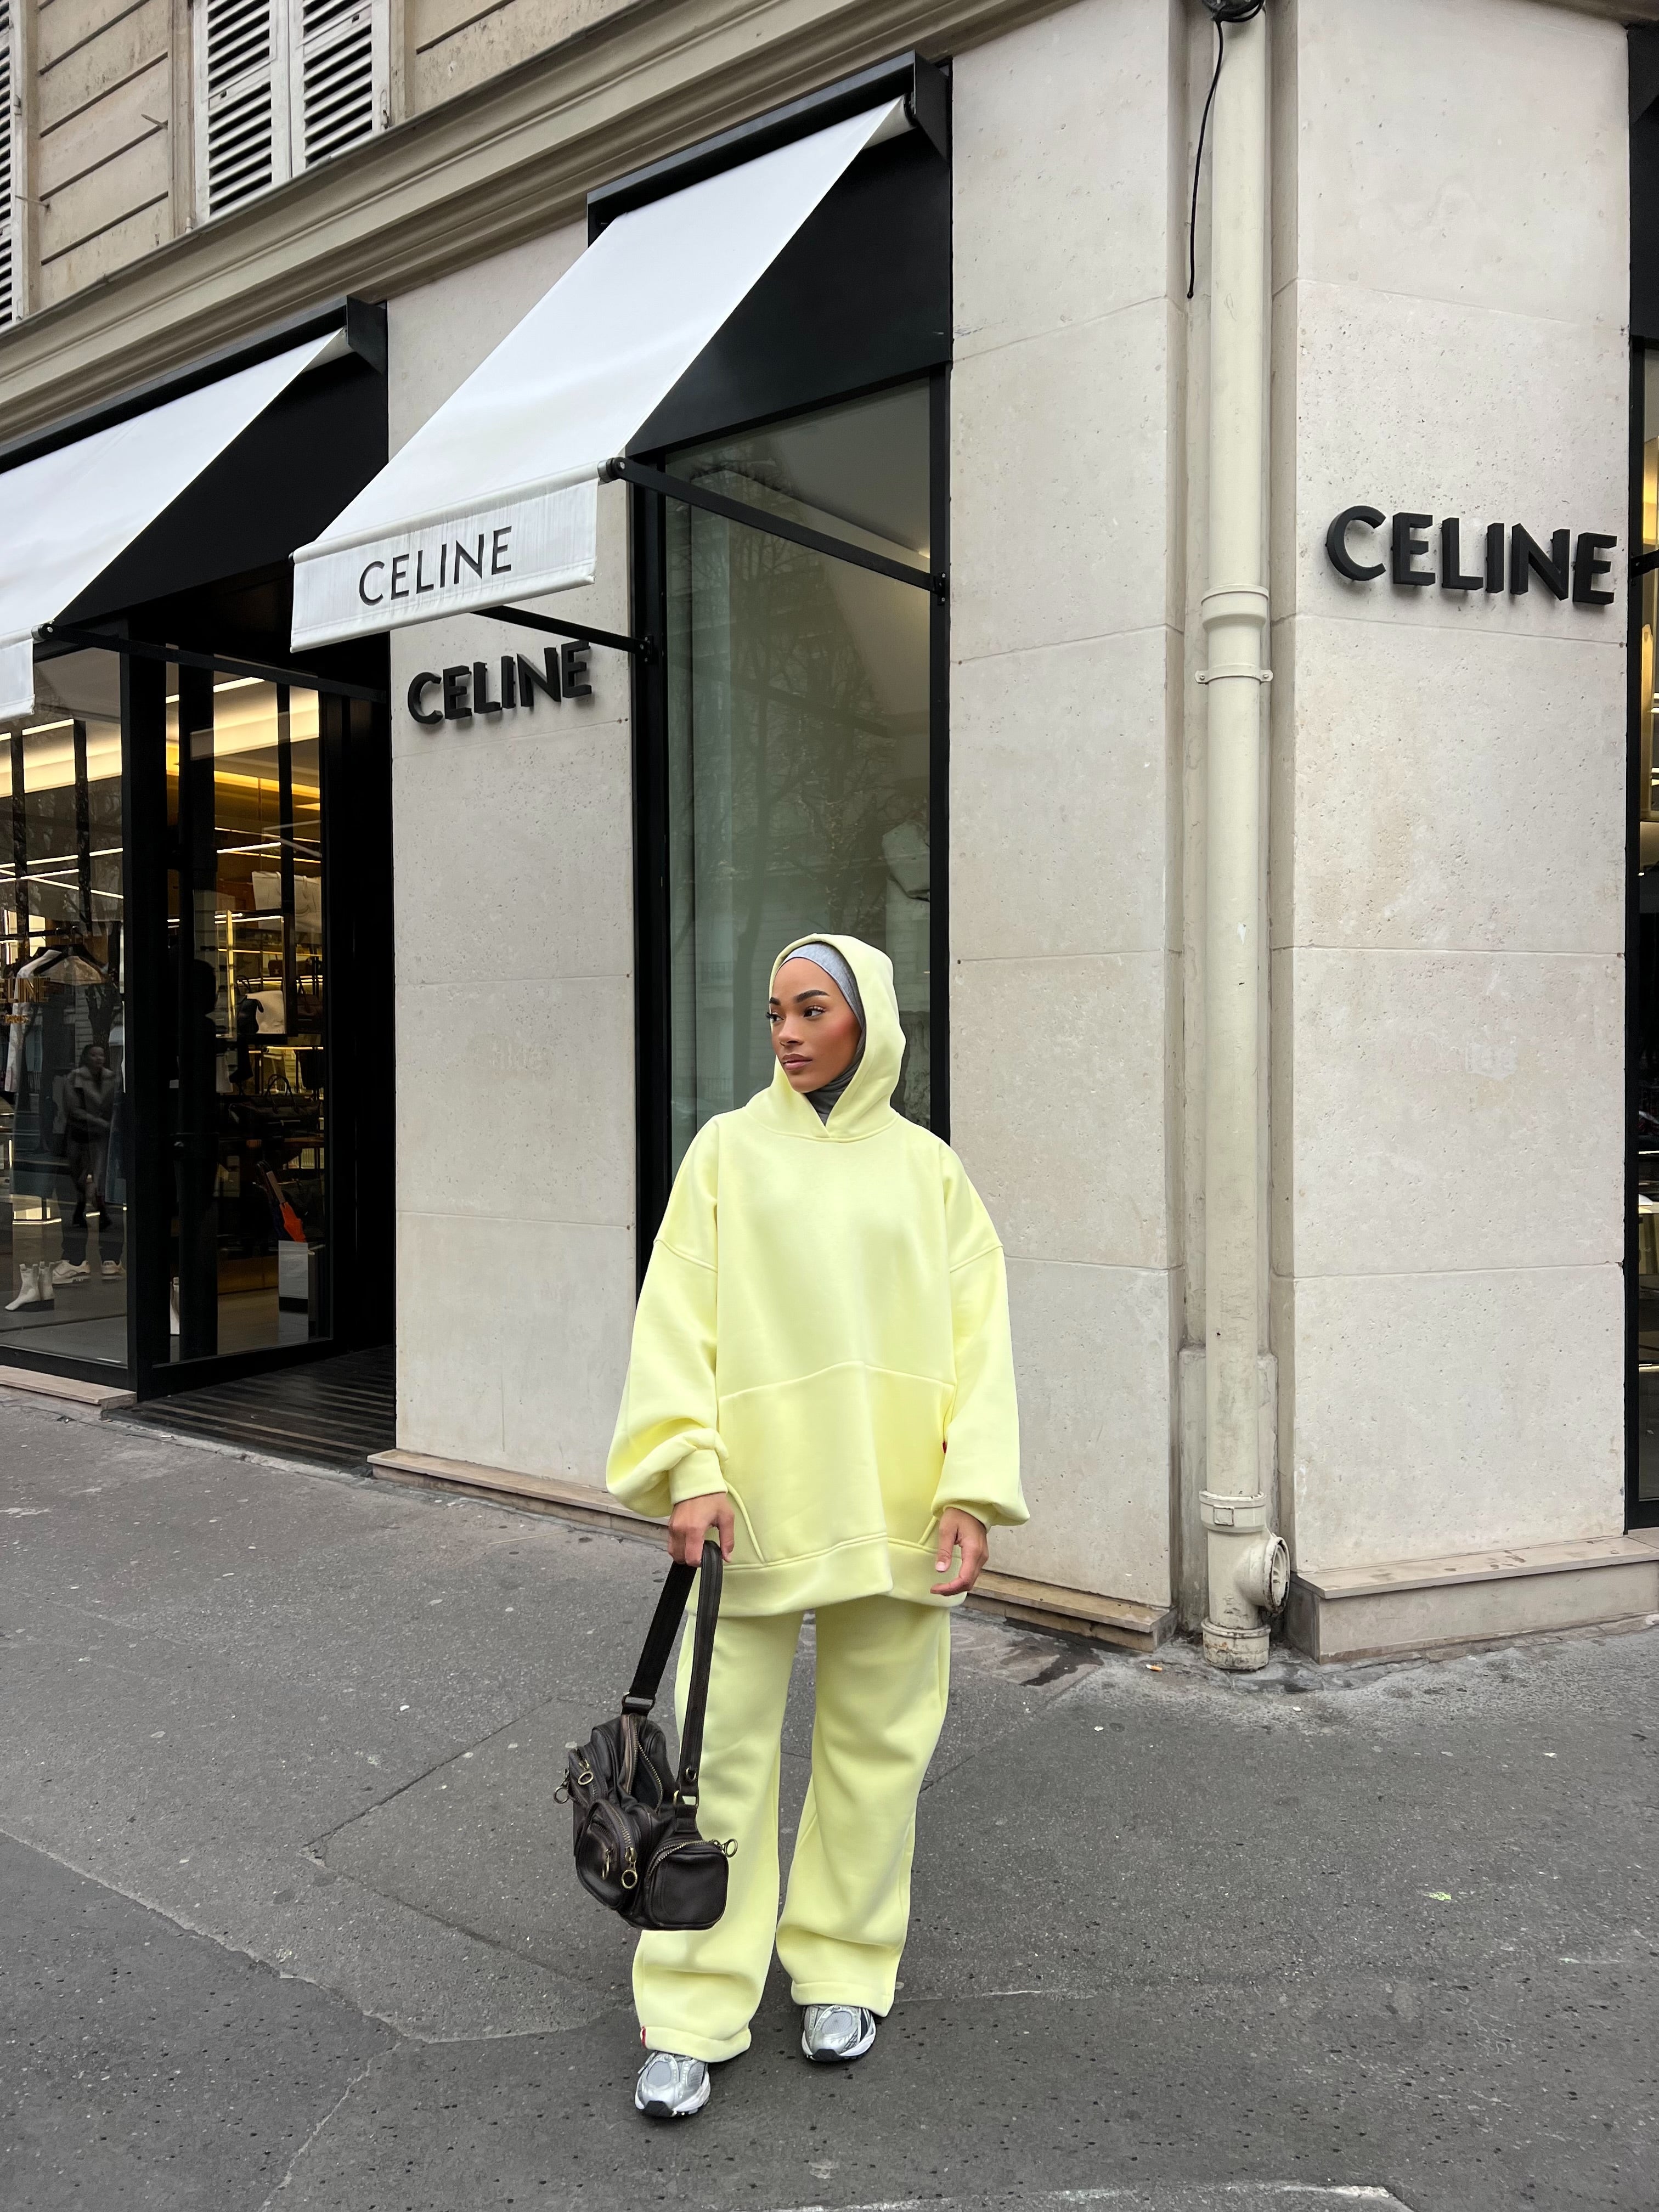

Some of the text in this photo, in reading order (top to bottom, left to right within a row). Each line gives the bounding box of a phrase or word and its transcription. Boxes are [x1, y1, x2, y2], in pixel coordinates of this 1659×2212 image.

[359, 526, 512, 606] CELINE
[1326, 505, 1617, 605] CELINE
[407, 639, 592, 725] CELINE
